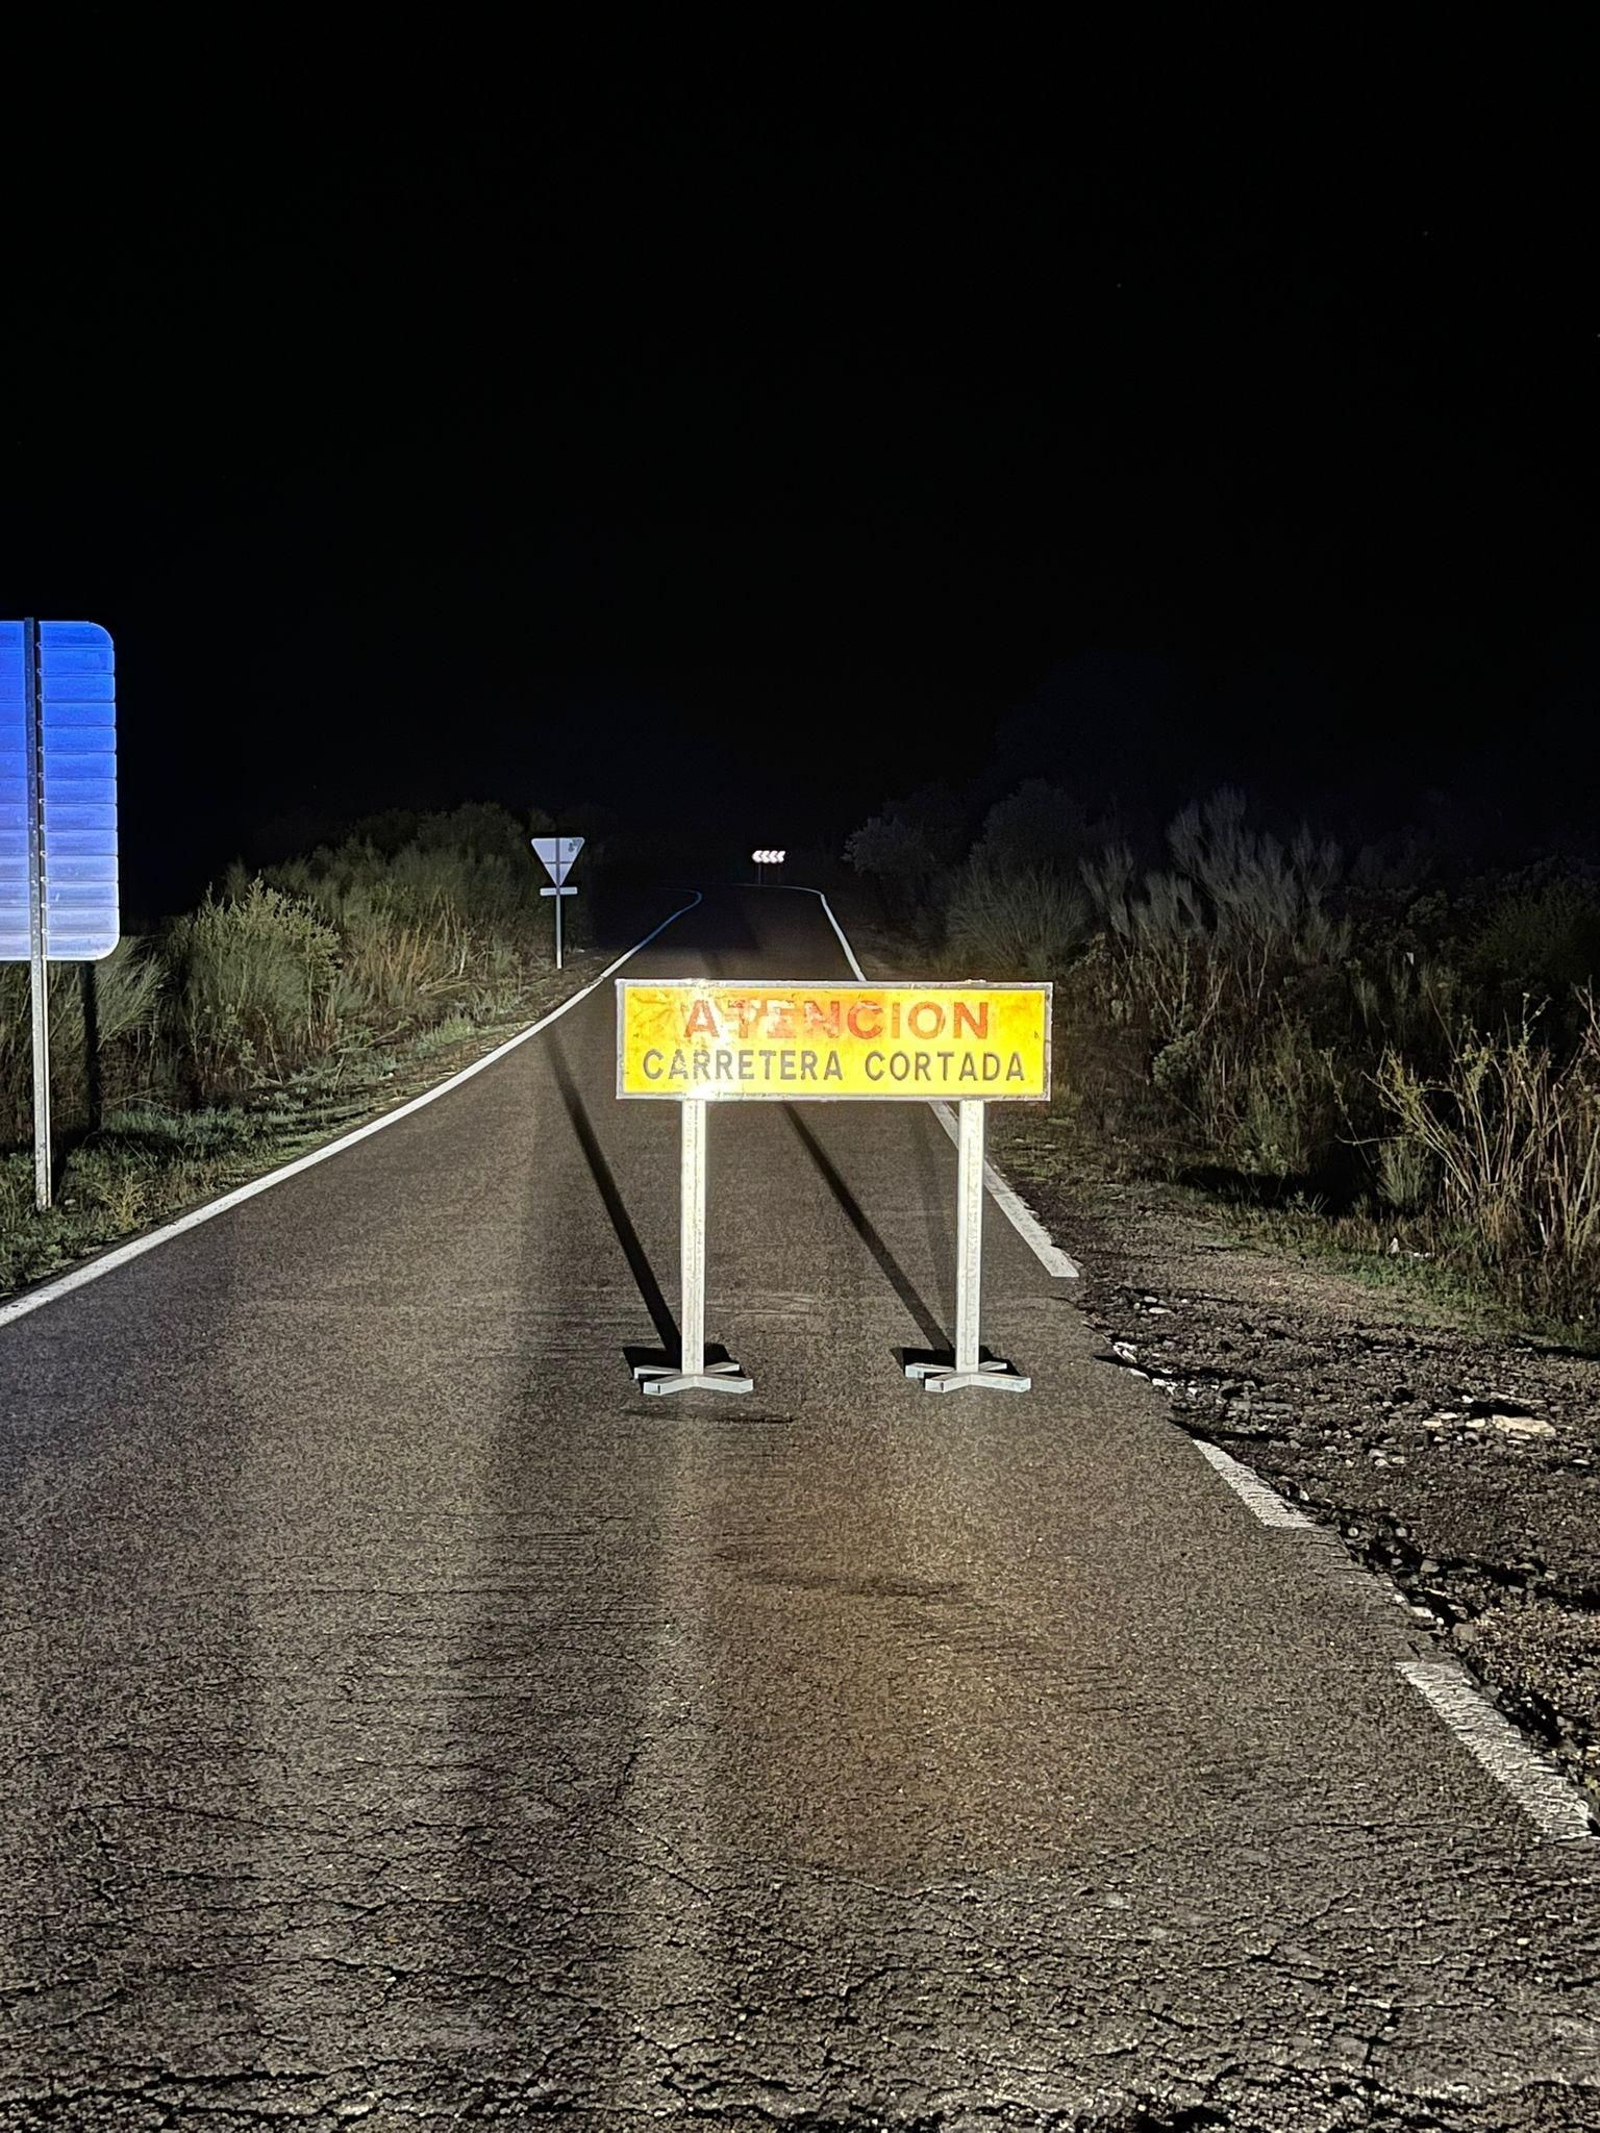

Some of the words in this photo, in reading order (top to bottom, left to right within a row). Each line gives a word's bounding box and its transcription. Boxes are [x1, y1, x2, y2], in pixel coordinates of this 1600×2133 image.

[684, 1000, 989, 1039] ATENCION
[643, 1049, 843, 1081] CARRETERA
[865, 1051, 1026, 1082] CORTADA
